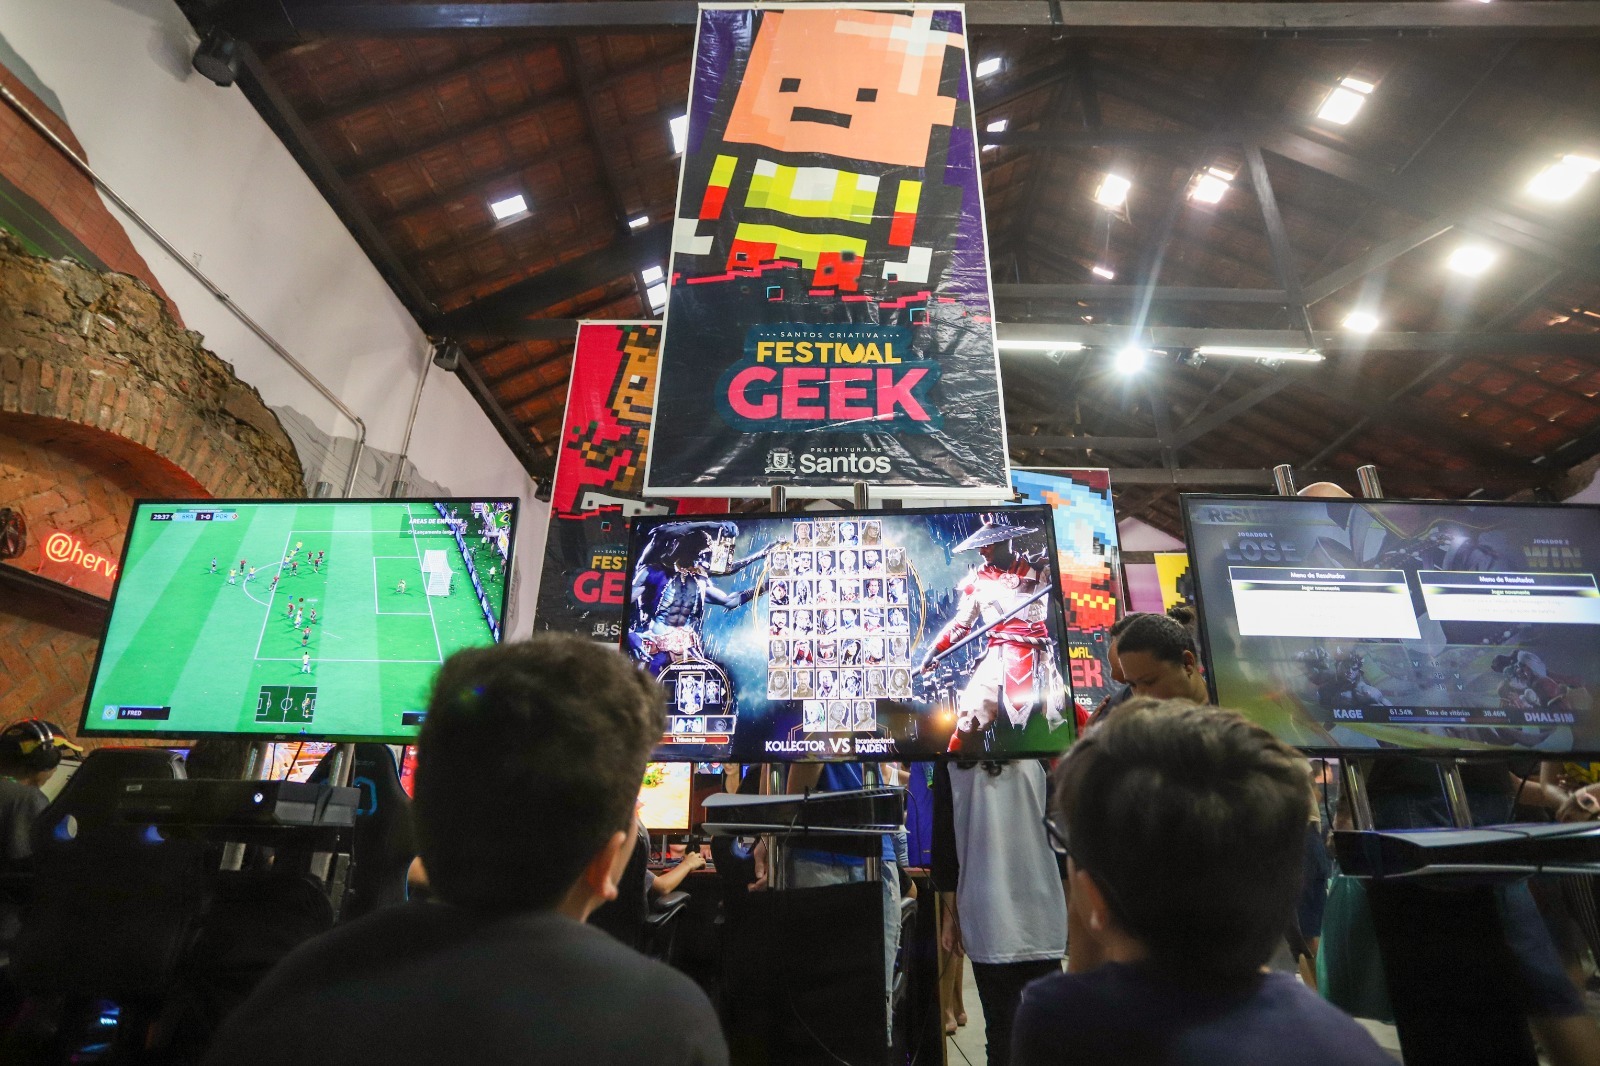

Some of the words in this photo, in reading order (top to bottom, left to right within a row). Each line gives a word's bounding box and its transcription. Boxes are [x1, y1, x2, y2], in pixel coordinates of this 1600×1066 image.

[781, 331, 823, 339] SANTOS
[757, 341, 902, 364] FESTIVAL
[728, 366, 932, 421] GEEK
[800, 453, 892, 474] Santos
[46, 532, 117, 580] @herv
[1221, 539, 1303, 562] LOSE
[1522, 545, 1583, 568] WIN
[1316, 572, 1346, 580] Resultados
[1479, 575, 1496, 583] Menu
[1504, 576, 1535, 584] Resultados
[1070, 659, 1103, 688] EK
[1333, 709, 1364, 719] KAGE
[1389, 708, 1413, 716] 61.54%
[1449, 709, 1471, 717] vitórias
[1524, 712, 1575, 723] DHALSIM
[765, 740, 826, 752] KOLLECTOR
[828, 737, 851, 753] VS
[855, 743, 888, 754] RAIDEN
